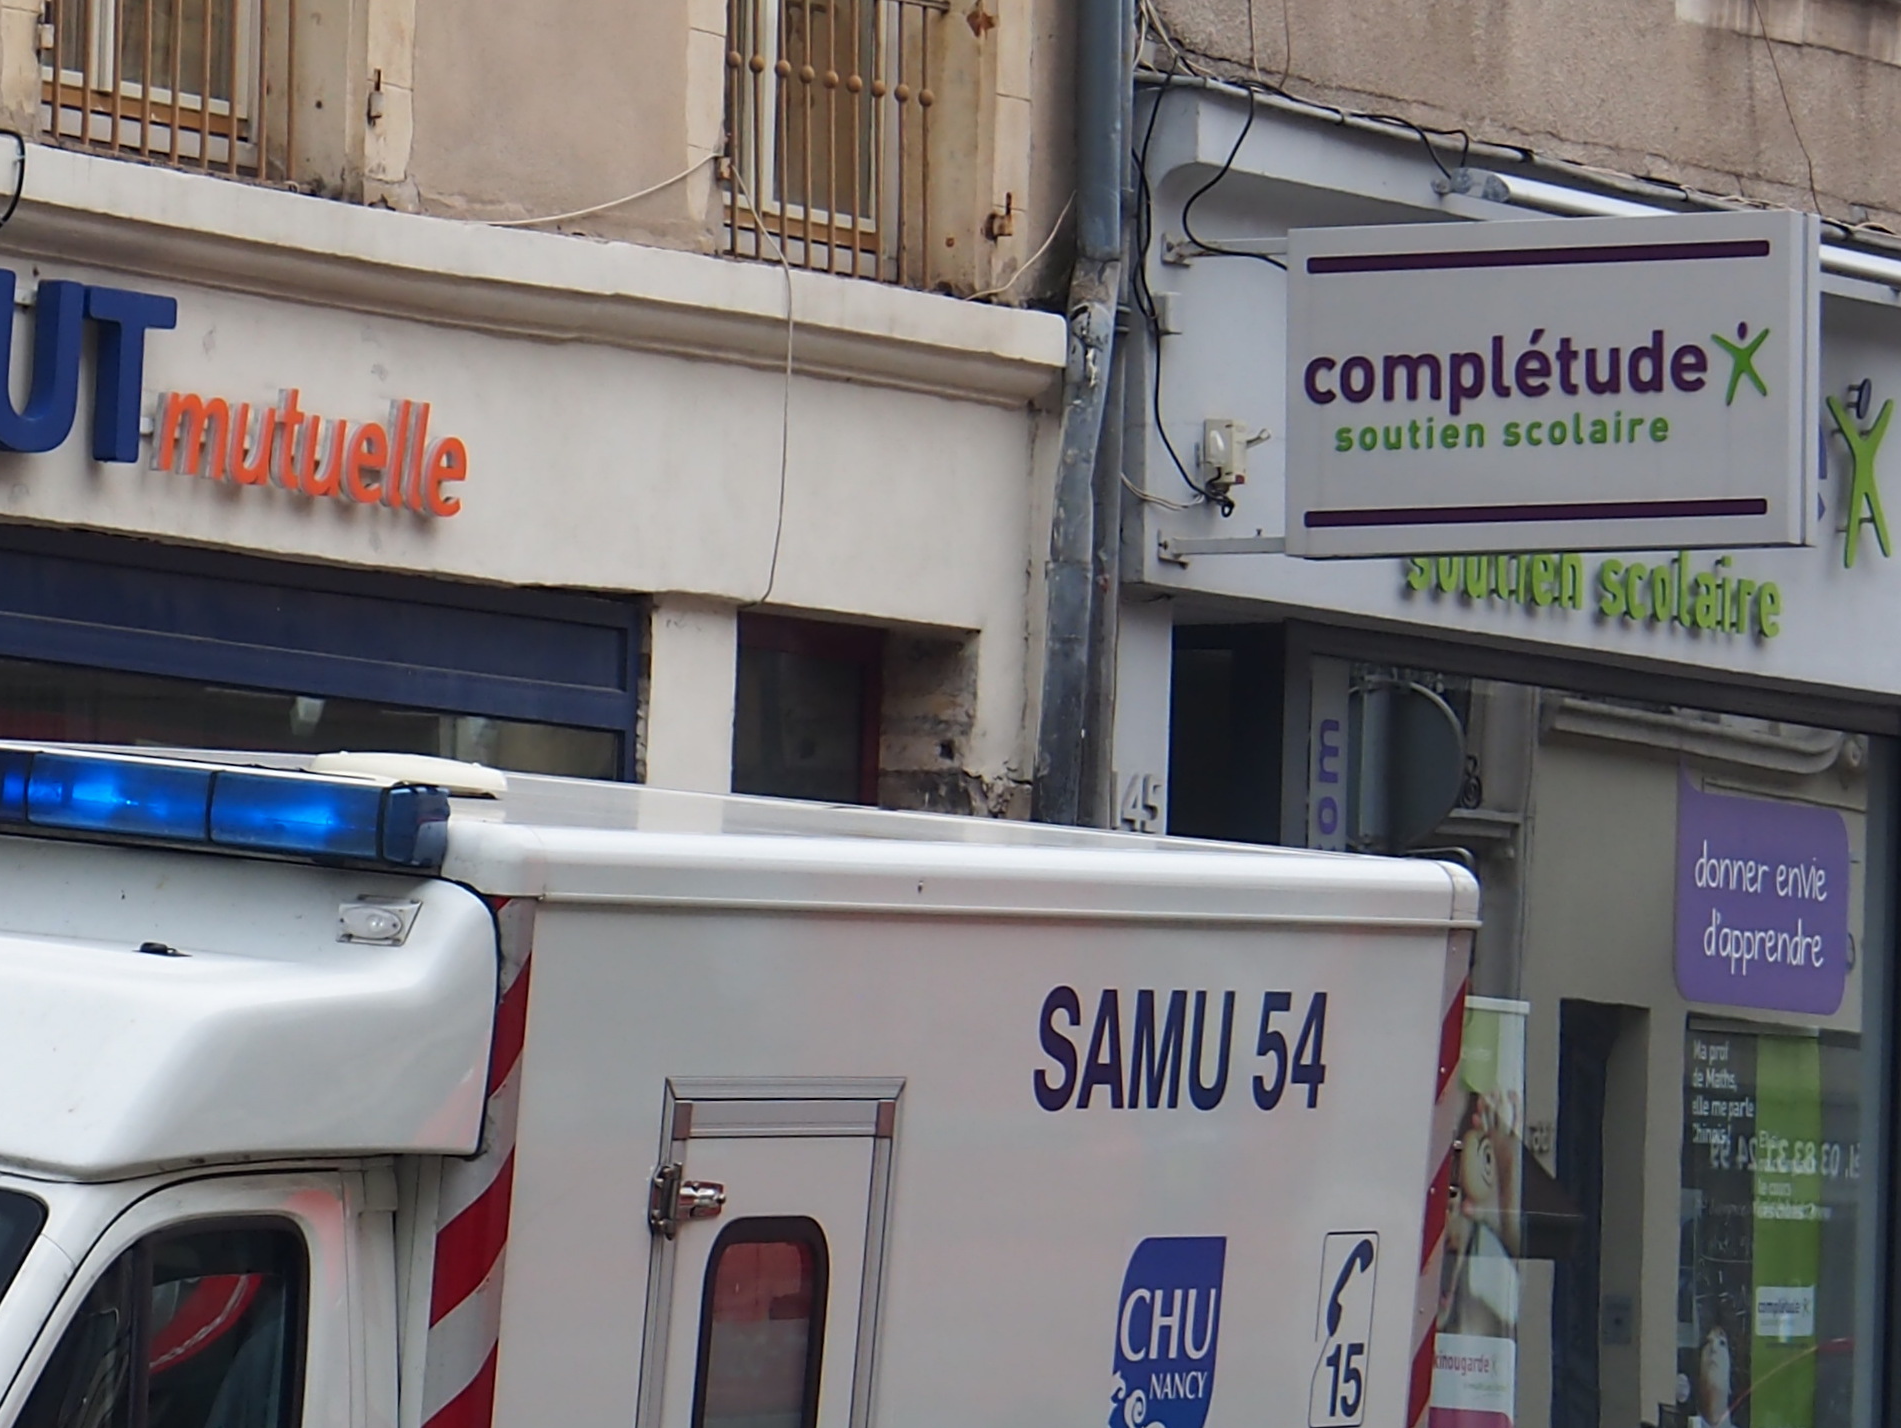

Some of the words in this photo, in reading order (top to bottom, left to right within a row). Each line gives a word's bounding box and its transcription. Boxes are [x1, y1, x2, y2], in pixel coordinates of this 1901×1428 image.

[1304, 328, 1708, 416] complétude
[156, 387, 468, 518] mutuelle
[1335, 417, 1485, 451] soutien
[1503, 410, 1669, 447] scolaire
[1599, 552, 1782, 638] scolaire
[1695, 839, 1769, 893] donner
[1776, 857, 1827, 901] envie
[1704, 908, 1823, 976] d'apprendre
[1033, 985, 1235, 1112] SAMU
[1252, 991, 1327, 1111] 54
[1709, 1041, 1728, 1065] prof
[1120, 1288, 1217, 1362] CHU
[1150, 1371, 1207, 1400] NANCY
[1326, 1342, 1365, 1417] 15
